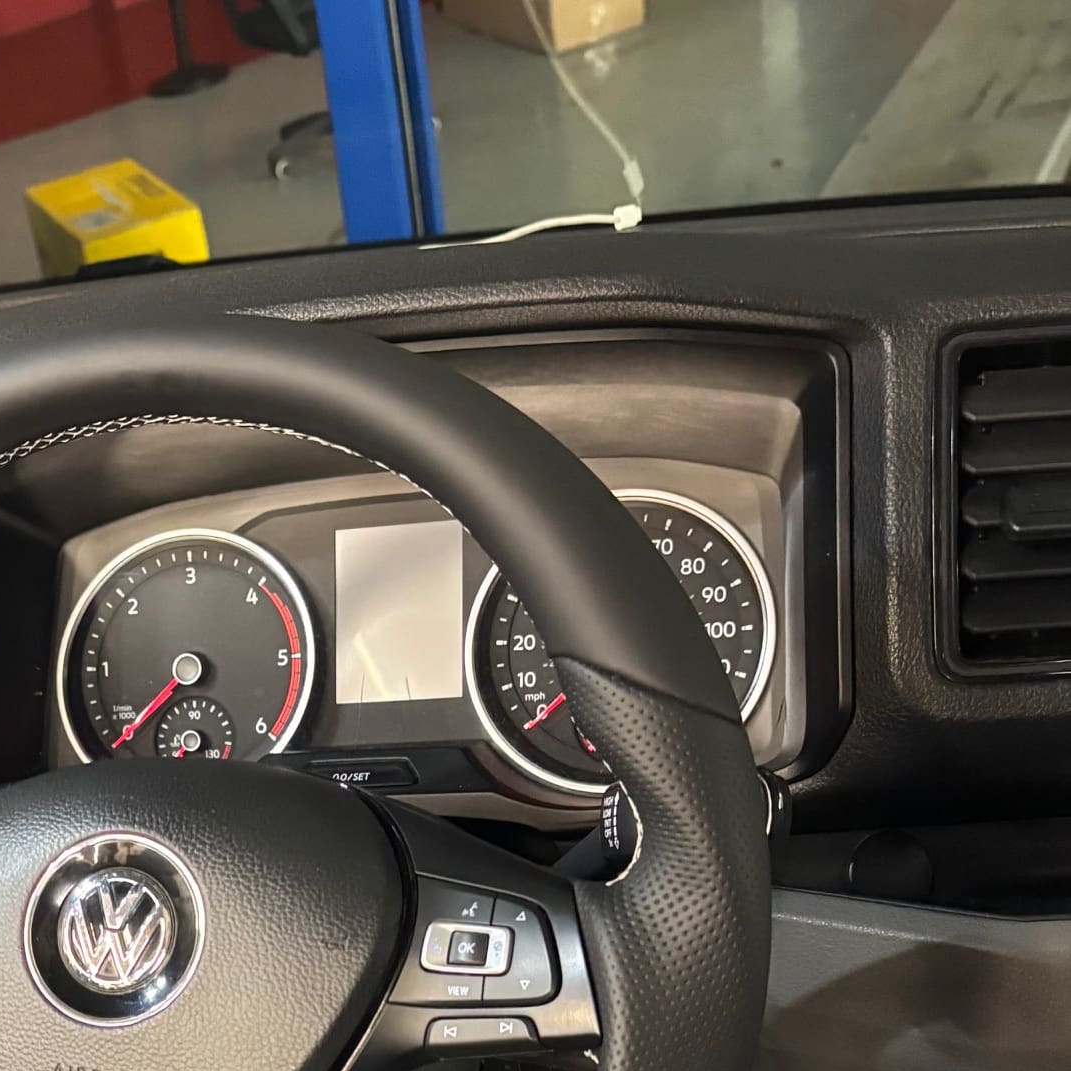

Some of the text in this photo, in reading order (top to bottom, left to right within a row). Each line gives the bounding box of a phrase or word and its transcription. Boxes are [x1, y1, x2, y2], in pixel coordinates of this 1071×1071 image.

[680, 557, 705, 575] 80
[185, 567, 196, 585] 3
[245, 587, 258, 604] 4
[702, 585, 727, 604] 90
[127, 598, 139, 615] 2
[704, 621, 736, 638] 100
[513, 634, 536, 651] 20
[277, 649, 288, 666] 5
[101, 661, 109, 678] 1
[517, 671, 537, 688] 10
[524, 691, 546, 702] mph
[118, 711, 136, 720] 1000
[188, 710, 201, 721] 90
[255, 717, 268, 734] 6
[204, 749, 220, 759] 130
[457, 942, 477, 954] OK
[447, 985, 469, 996] VIEW
